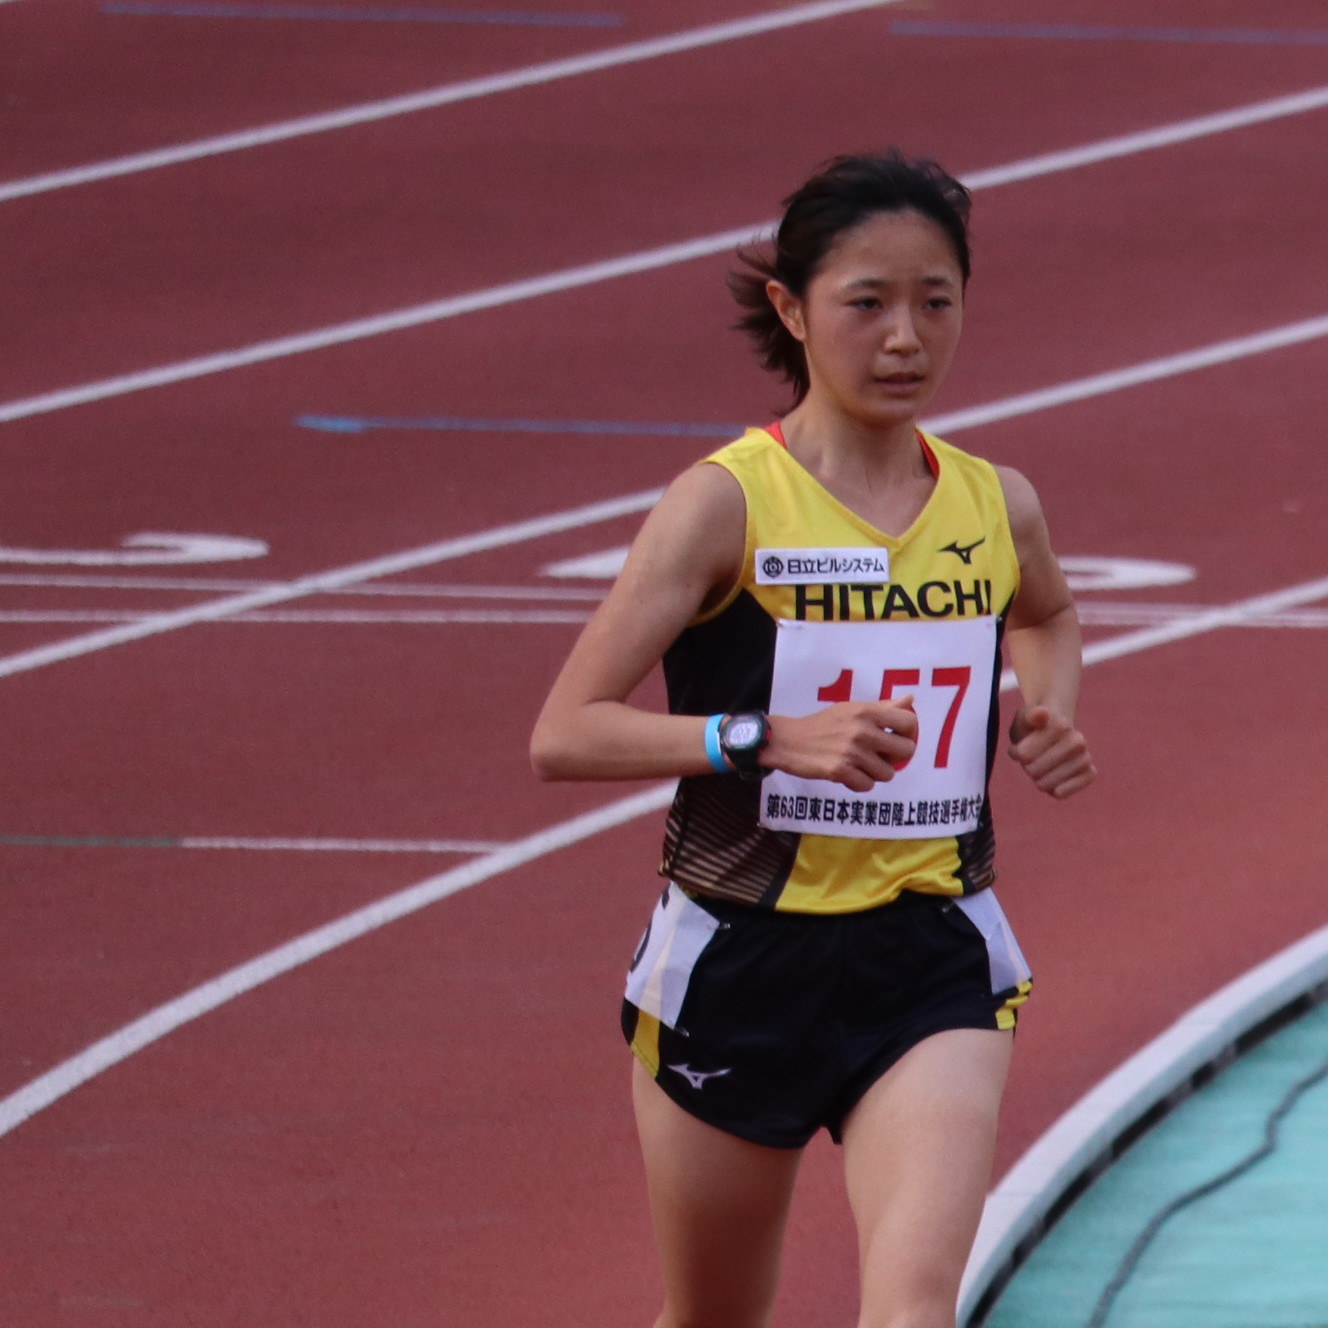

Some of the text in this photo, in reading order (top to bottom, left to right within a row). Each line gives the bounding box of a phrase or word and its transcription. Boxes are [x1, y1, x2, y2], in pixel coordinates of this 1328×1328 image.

[788, 557, 884, 577] 日立ビルシステム
[795, 581, 991, 620] HITACHI
